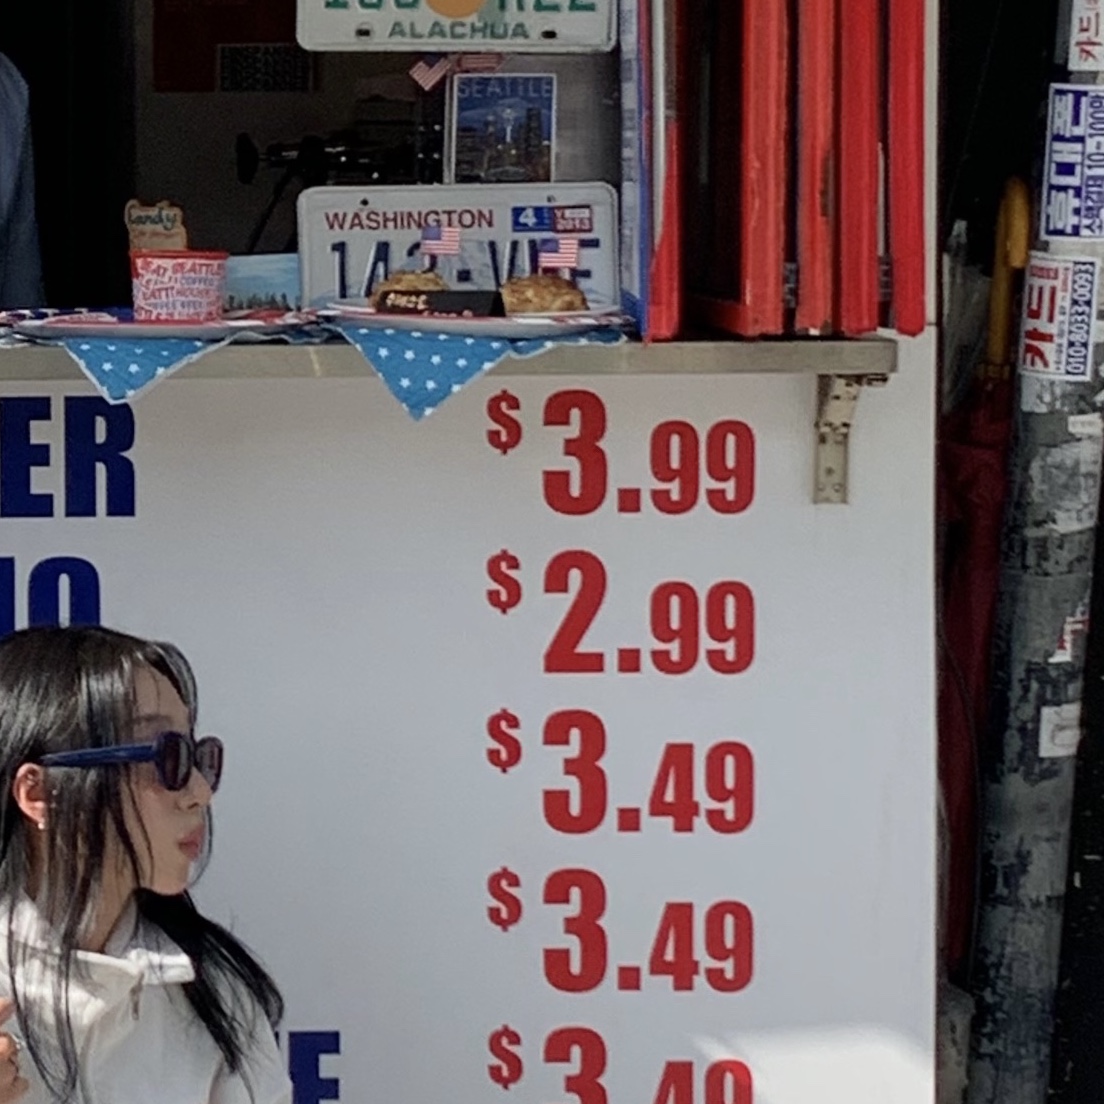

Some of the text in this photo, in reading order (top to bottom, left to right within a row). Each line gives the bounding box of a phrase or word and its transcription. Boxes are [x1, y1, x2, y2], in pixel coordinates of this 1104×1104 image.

[387, 21, 531, 41] ALACHUA
[457, 79, 552, 98] SEATTLE
[324, 209, 495, 231] WASHINGTON
[1048, 90, 1087, 235] 휴대폰
[1023, 283, 1057, 369] 카드
[487, 389, 756, 516] $3.99
[487, 549, 756, 675] $2.99
[487, 708, 755, 835] $3.49
[487, 867, 755, 993] $3.49
